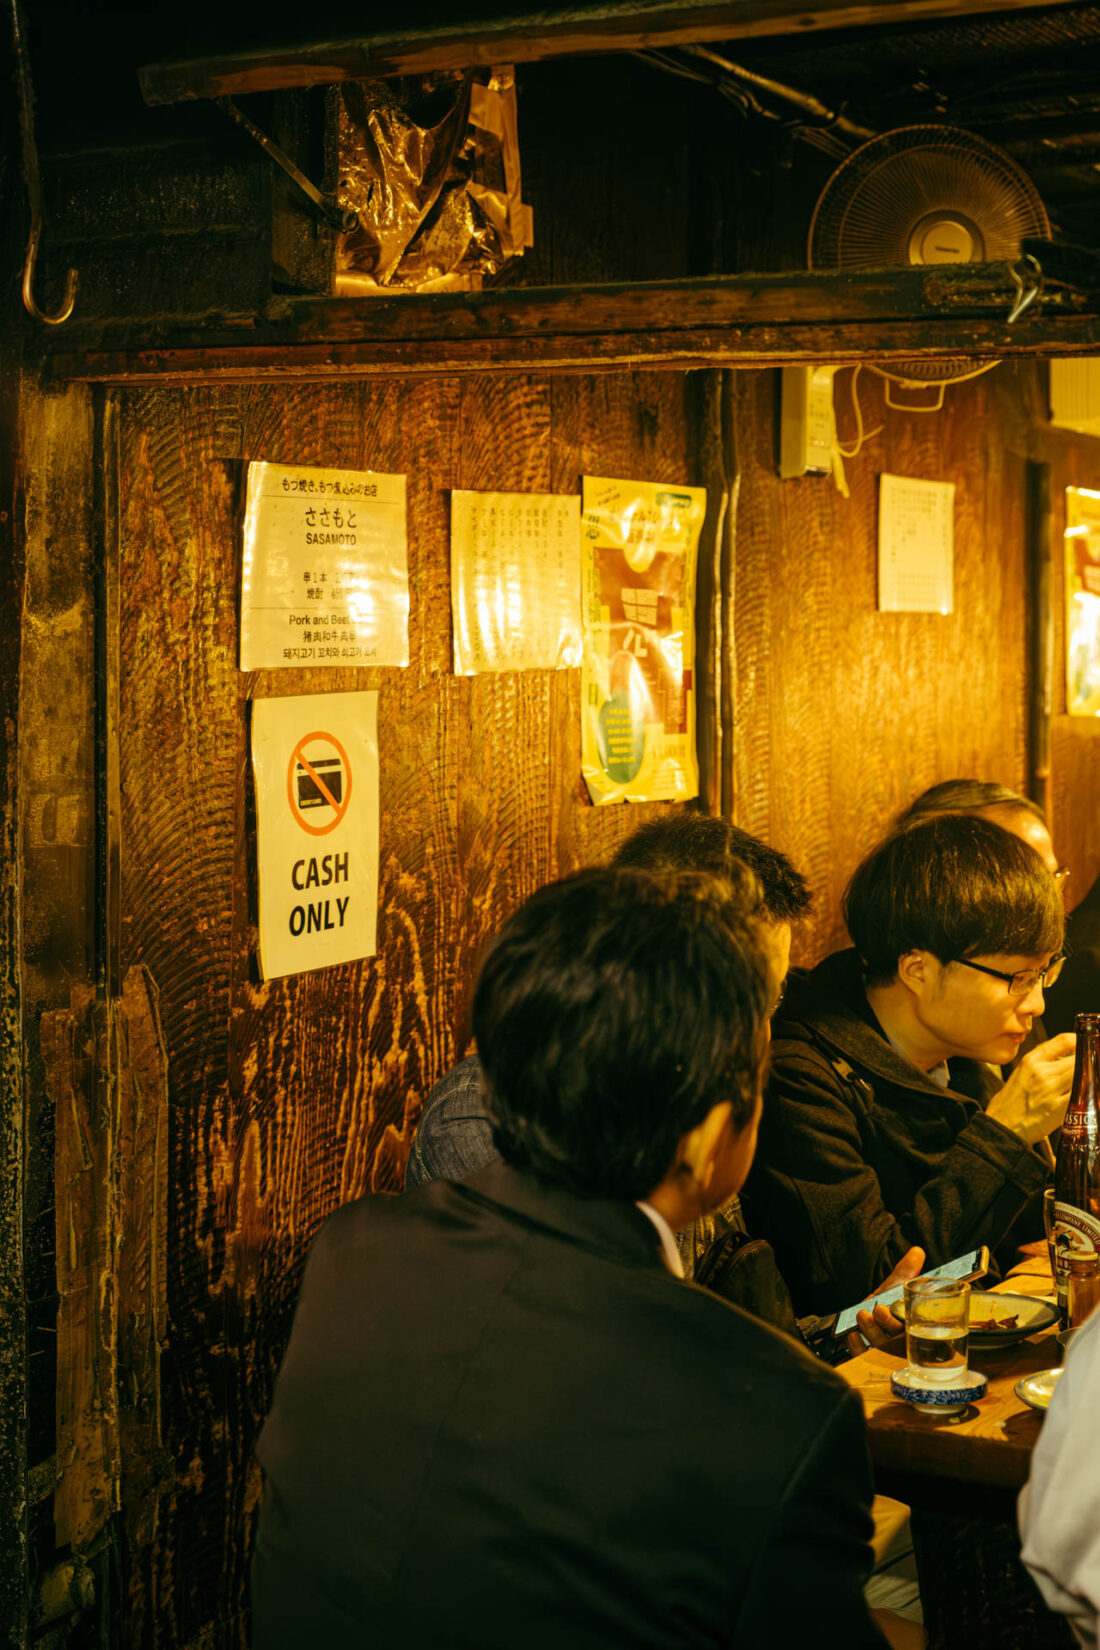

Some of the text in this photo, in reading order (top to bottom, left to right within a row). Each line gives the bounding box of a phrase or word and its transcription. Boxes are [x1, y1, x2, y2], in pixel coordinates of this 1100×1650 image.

[304, 506, 357, 529] ささもと
[306, 532, 357, 546] SASAMOTO
[289, 614, 311, 625] Pork
[312, 615, 329, 625] and
[282, 647, 316, 660] 돼지고기
[291, 851, 349, 891] CASH
[288, 896, 350, 937] ONLY
